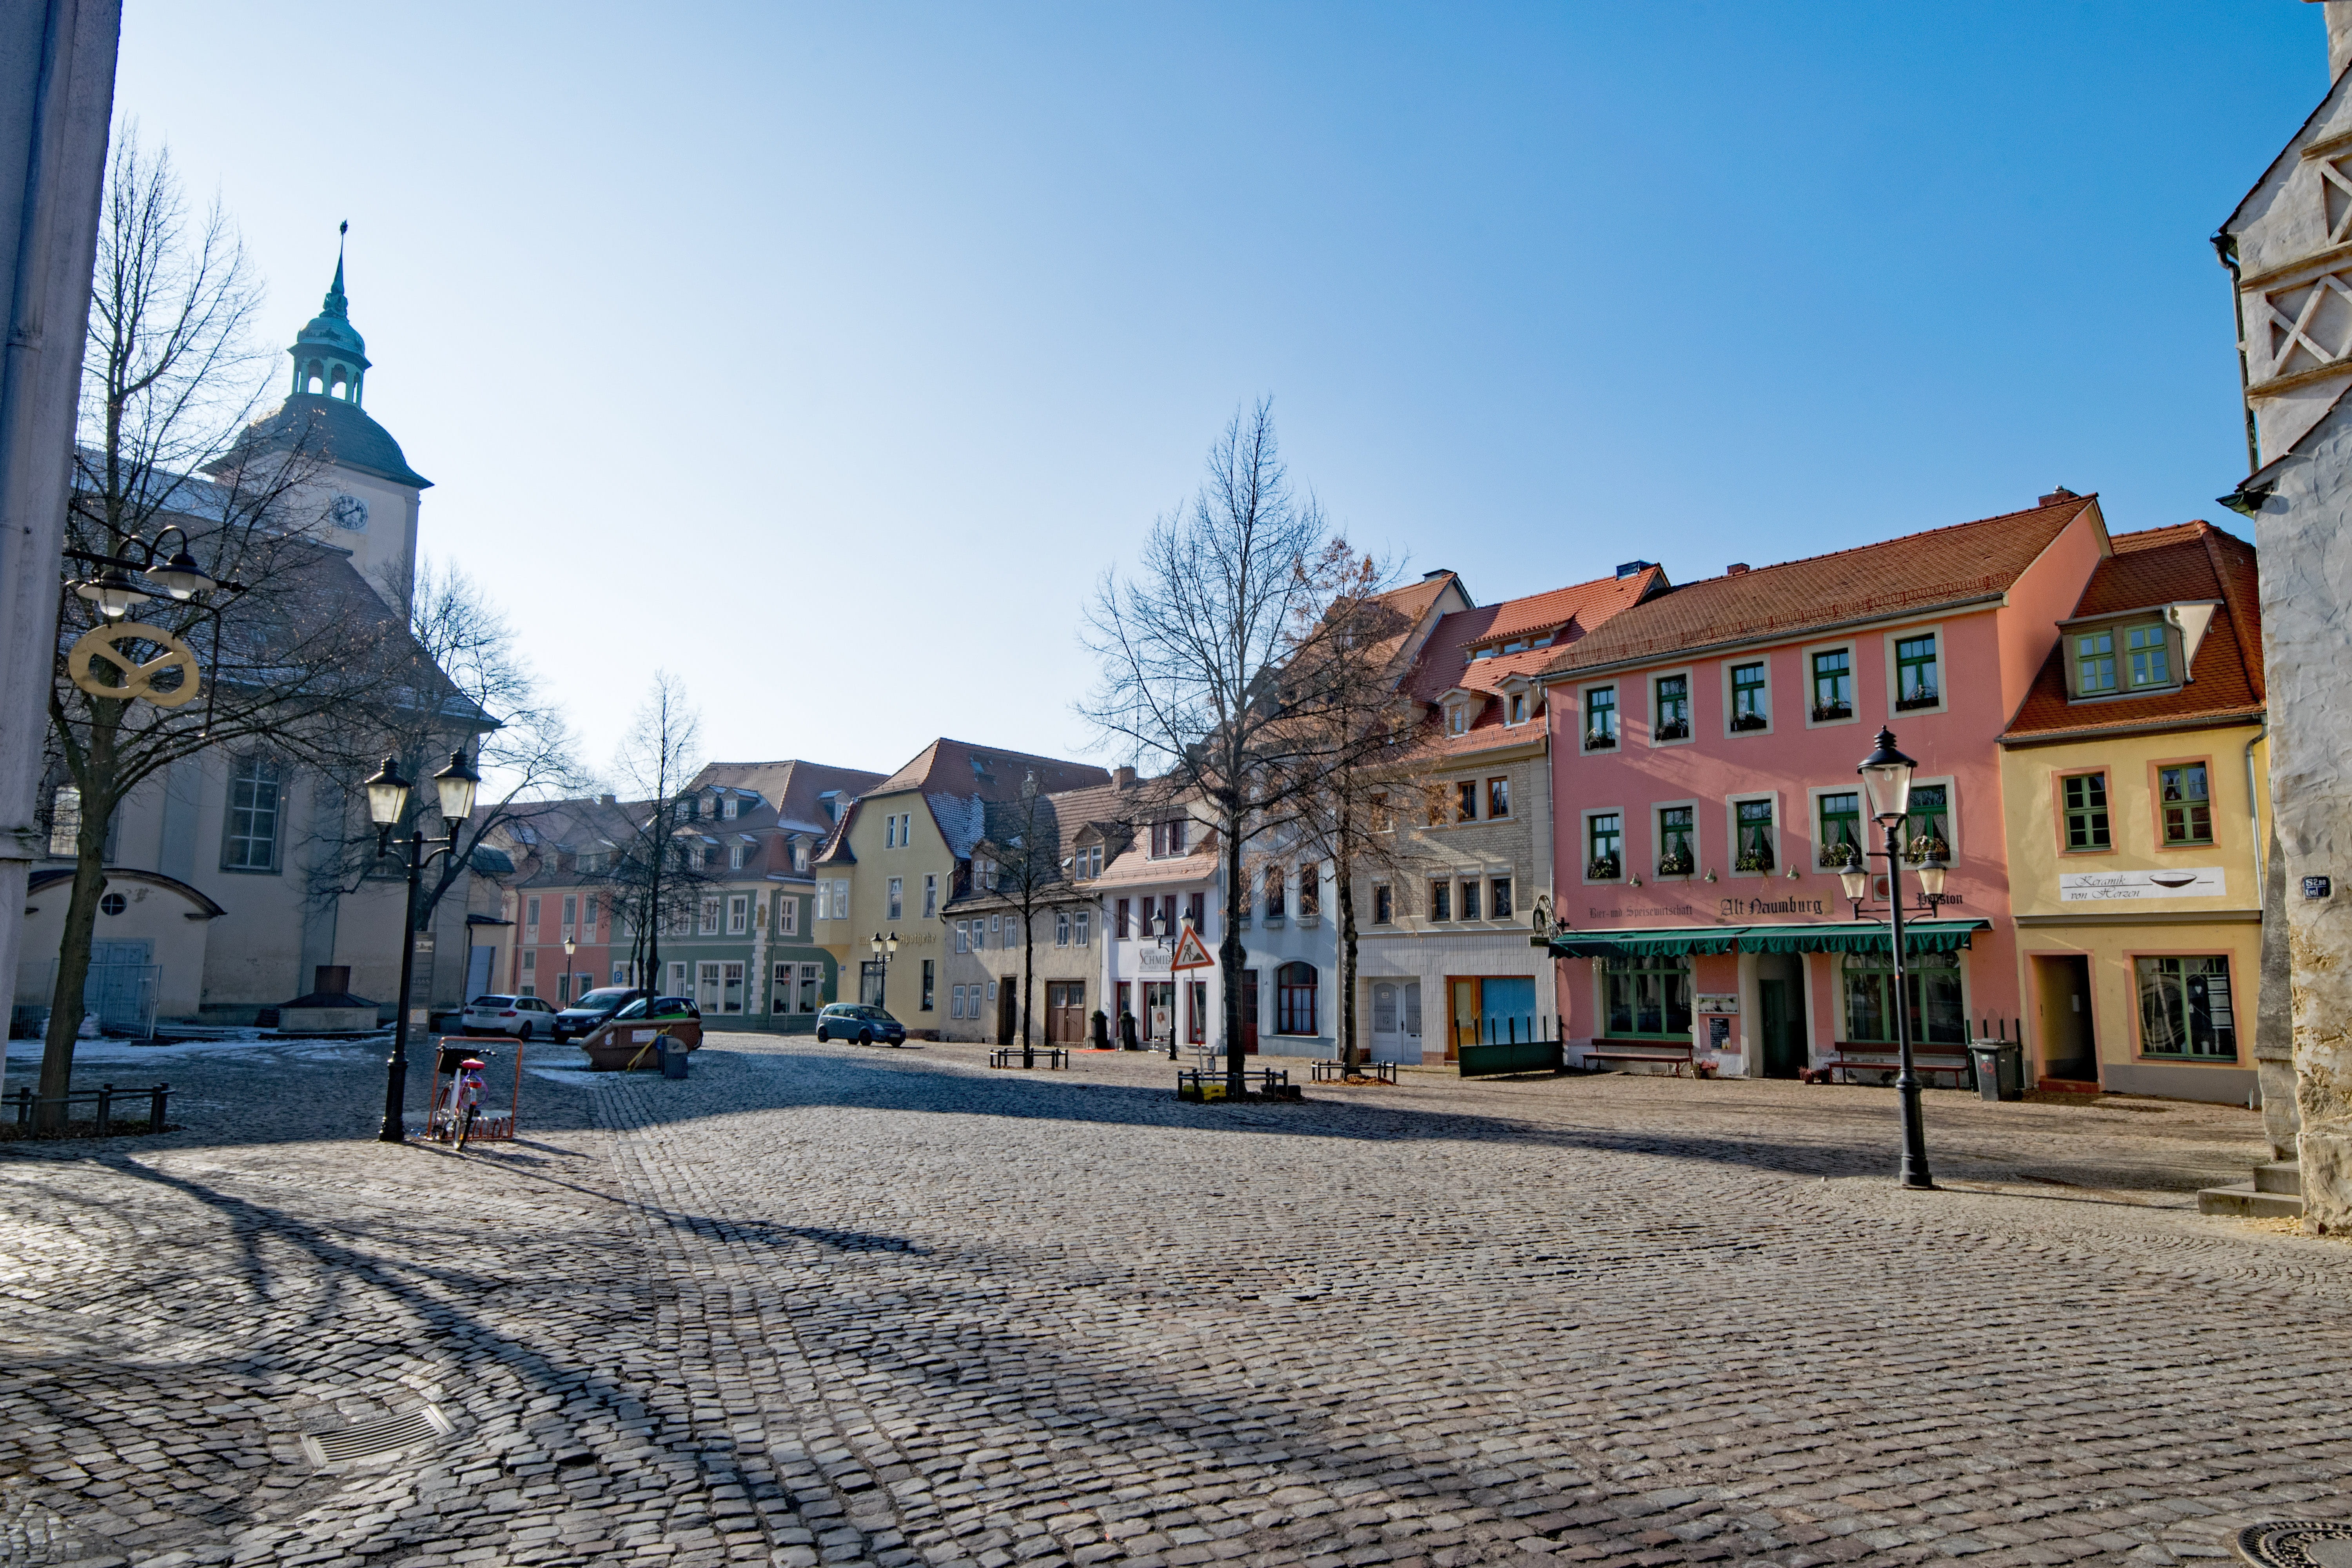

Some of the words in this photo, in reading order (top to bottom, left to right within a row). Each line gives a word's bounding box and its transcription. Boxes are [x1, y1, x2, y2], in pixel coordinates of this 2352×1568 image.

[2075, 875, 2126, 886] Keramik
[1916, 891, 1963, 909] Psion
[2092, 887, 2140, 899] Herzen
[1626, 905, 1693, 918] Speisewirtschaft
[1720, 898, 1744, 916] Alt
[1748, 895, 1823, 915] Naumburg
[900, 932, 936, 947] Apotheke
[1140, 949, 1171, 965] SCHMID
